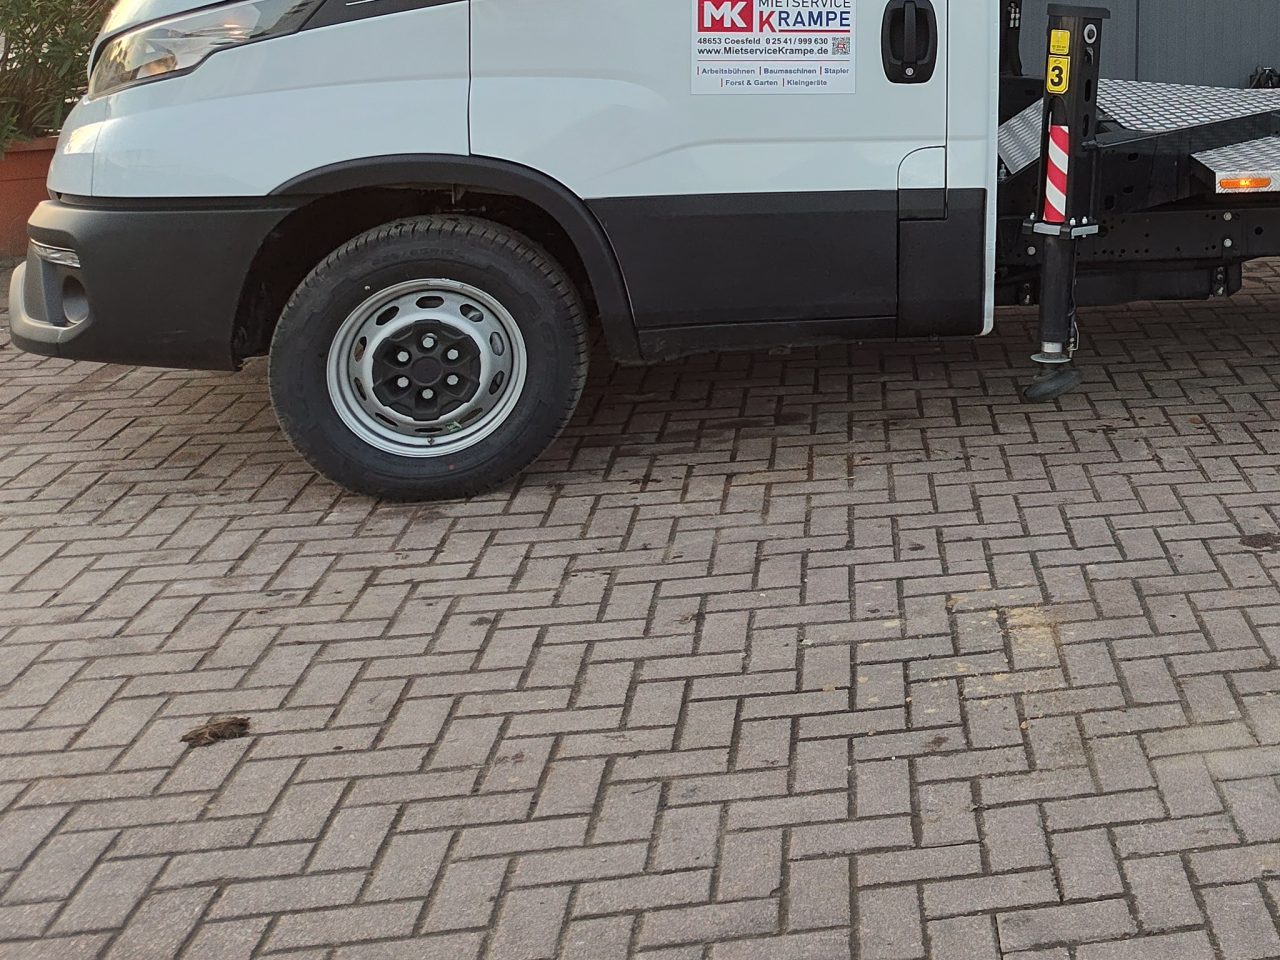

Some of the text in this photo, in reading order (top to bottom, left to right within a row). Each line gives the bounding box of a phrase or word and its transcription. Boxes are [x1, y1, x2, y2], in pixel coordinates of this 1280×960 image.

[703, 1, 748, 28] MK
[759, 10, 850, 33] KRAMPE
[697, 37, 722, 45] 48653
[724, 37, 761, 45] Coesfeld
[697, 47, 829, 56] www.MietserviceKrampe.de
[701, 67, 850, 76] Arbeitsbühnen Baumaschinen Stapler
[1050, 65, 1063, 87] 3
[725, 79, 745, 87] Forst
[754, 79, 778, 87] Garten
[787, 79, 827, 88] Kleingeräte
